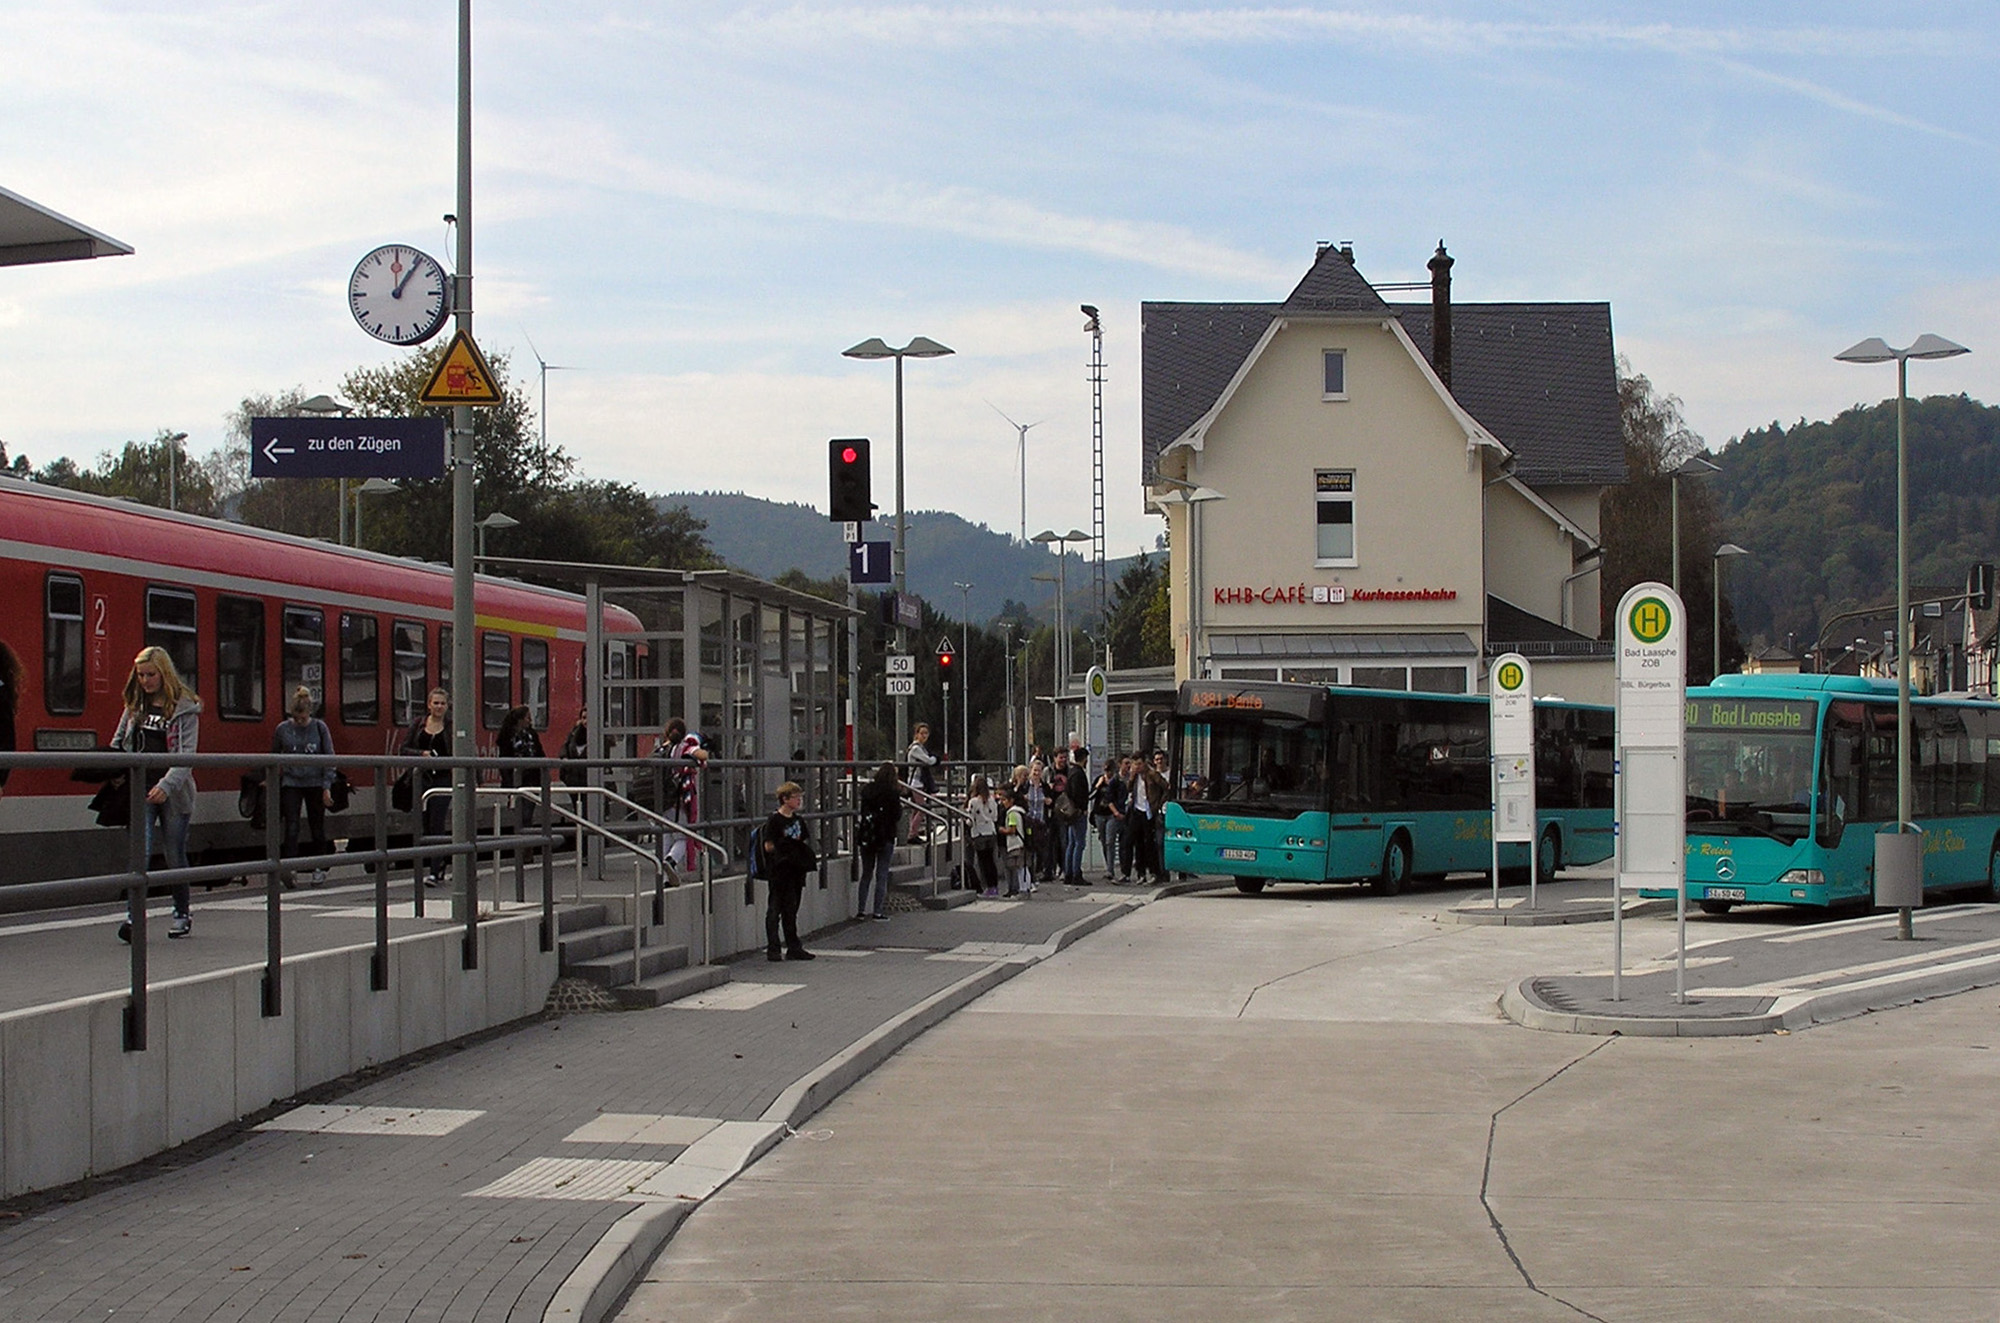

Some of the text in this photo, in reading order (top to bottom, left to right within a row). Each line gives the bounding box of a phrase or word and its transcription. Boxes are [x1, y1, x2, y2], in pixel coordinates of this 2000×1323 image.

[308, 436, 401, 453] zu den Zügen
[856, 544, 868, 573] 1
[1214, 583, 1457, 604] KHB-CAFÉ Kurhessenbahn
[95, 599, 105, 635] 2
[1641, 607, 1658, 633] H
[1624, 649, 1677, 658] Bad Laasphe
[893, 659, 908, 671] 50
[1641, 659, 1660, 667] ZOB
[1505, 669, 1516, 684] H
[890, 681, 911, 692] 100
[1712, 703, 1739, 725] Bad
[1741, 704, 1801, 727] Laasphe
